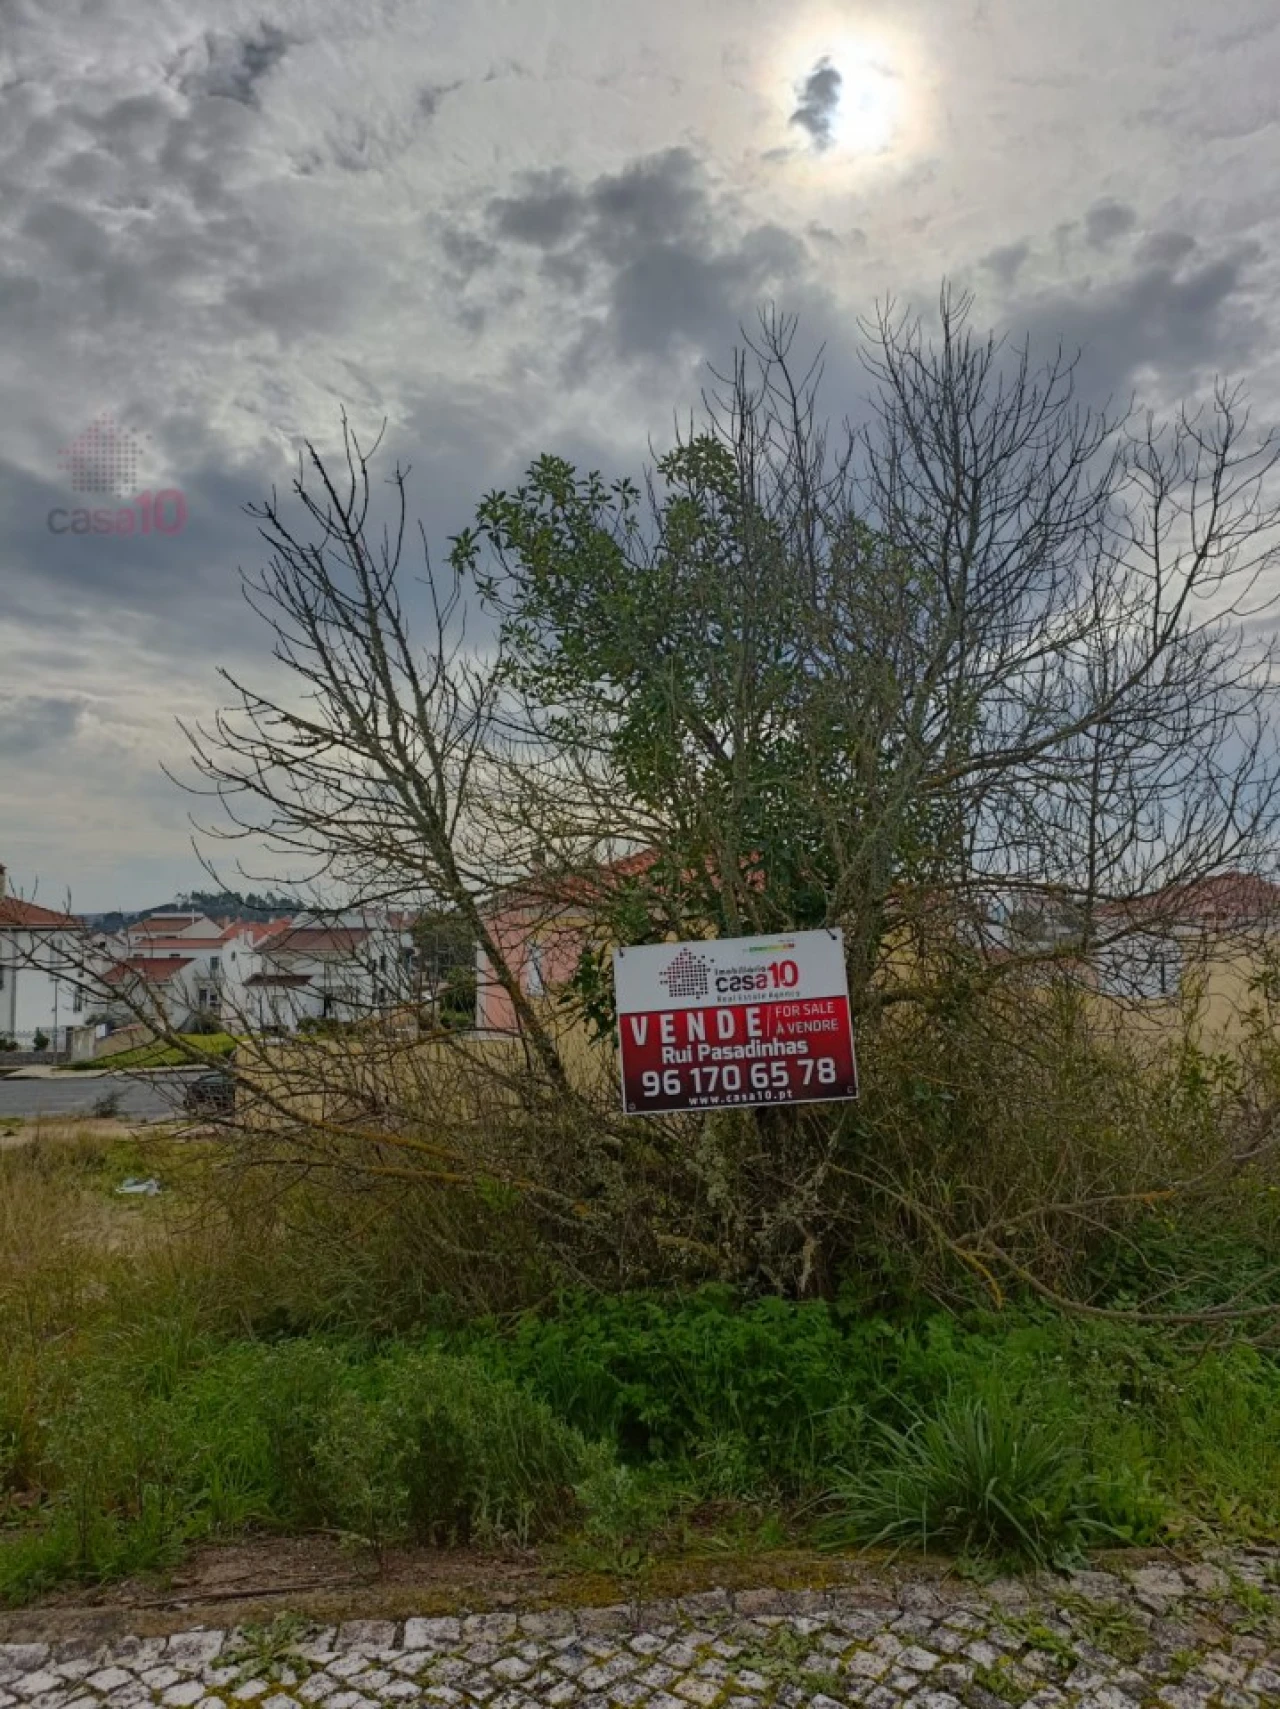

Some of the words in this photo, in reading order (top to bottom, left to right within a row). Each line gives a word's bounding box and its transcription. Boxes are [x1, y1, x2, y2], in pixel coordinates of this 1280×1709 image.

[715, 960, 799, 993] casa10
[775, 1005, 800, 1016] FOR
[803, 1002, 835, 1014] SALE
[631, 1007, 762, 1046] VENDE
[788, 1019, 838, 1032] VENDRE
[662, 1046, 692, 1064] Rui
[698, 1038, 808, 1062] Pasadinhas
[642, 1070, 681, 1097] 96
[690, 1065, 740, 1093] 170
[750, 1061, 789, 1089] 65
[798, 1058, 836, 1085] 78
[688, 1089, 793, 1105] www.casa10.pt
